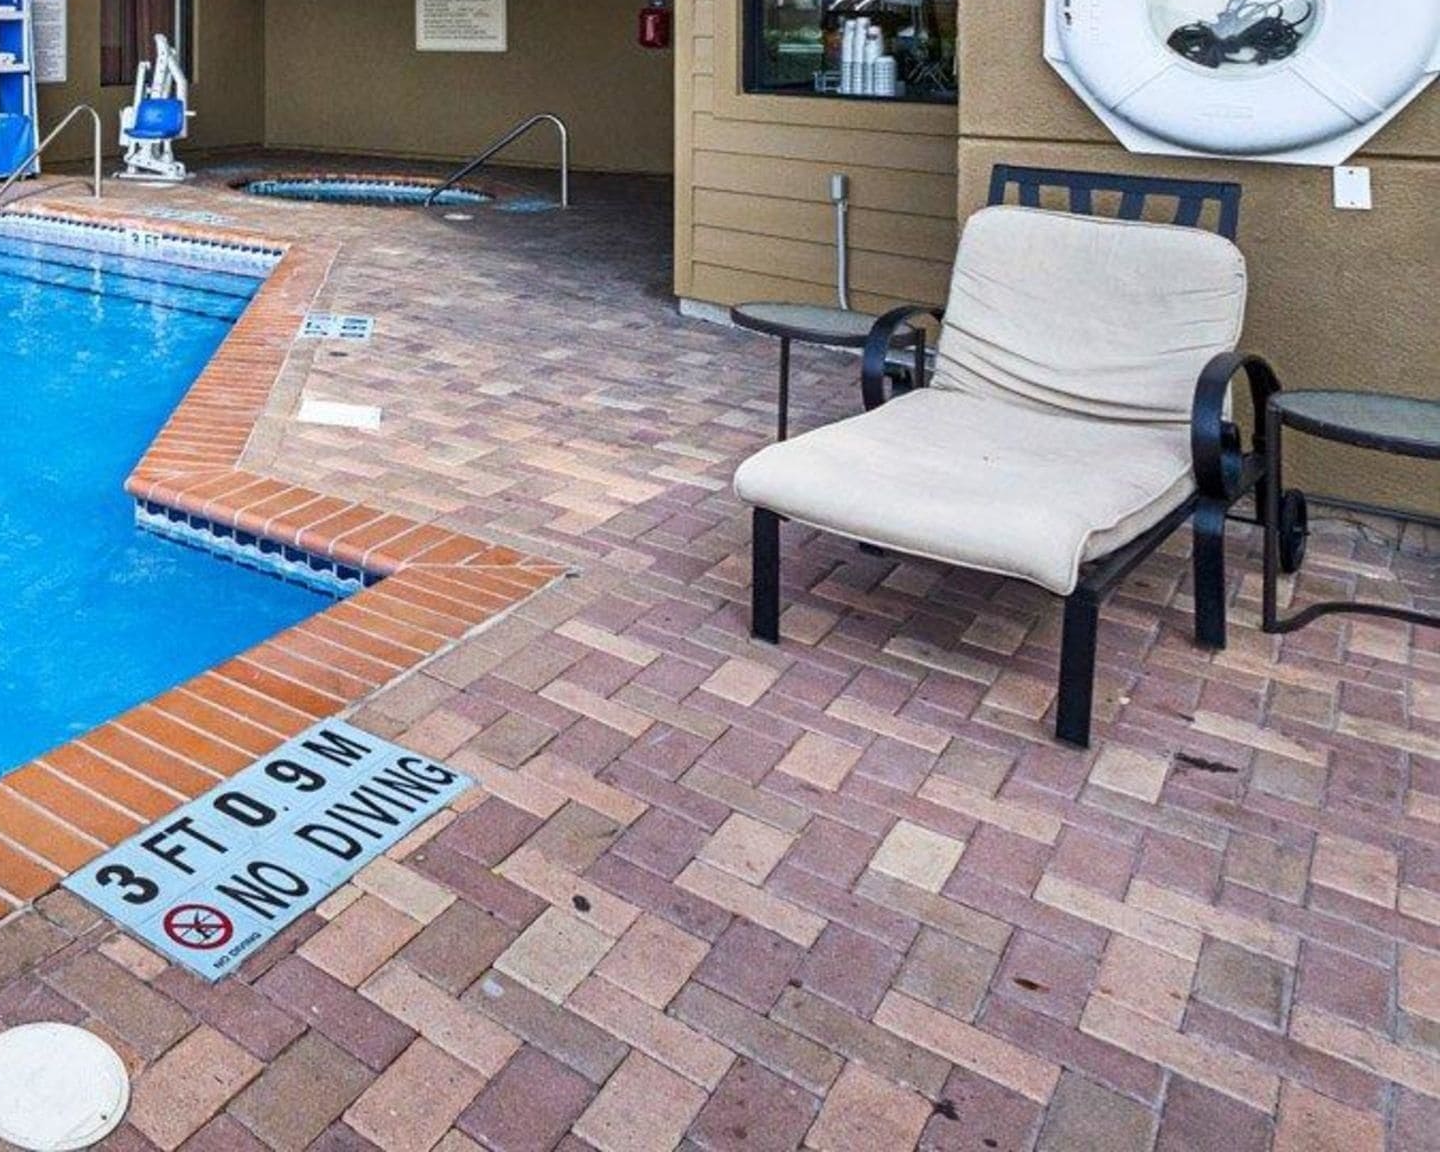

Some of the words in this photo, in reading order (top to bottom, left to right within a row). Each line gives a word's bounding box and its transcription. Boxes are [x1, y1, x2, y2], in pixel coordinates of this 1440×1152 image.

[145, 234, 160, 249] FT
[95, 863, 159, 906] 3
[140, 816, 229, 876] FT
[301, 729, 373, 767] M
[215, 861, 310, 921] NO
[294, 756, 459, 861] DIVING
